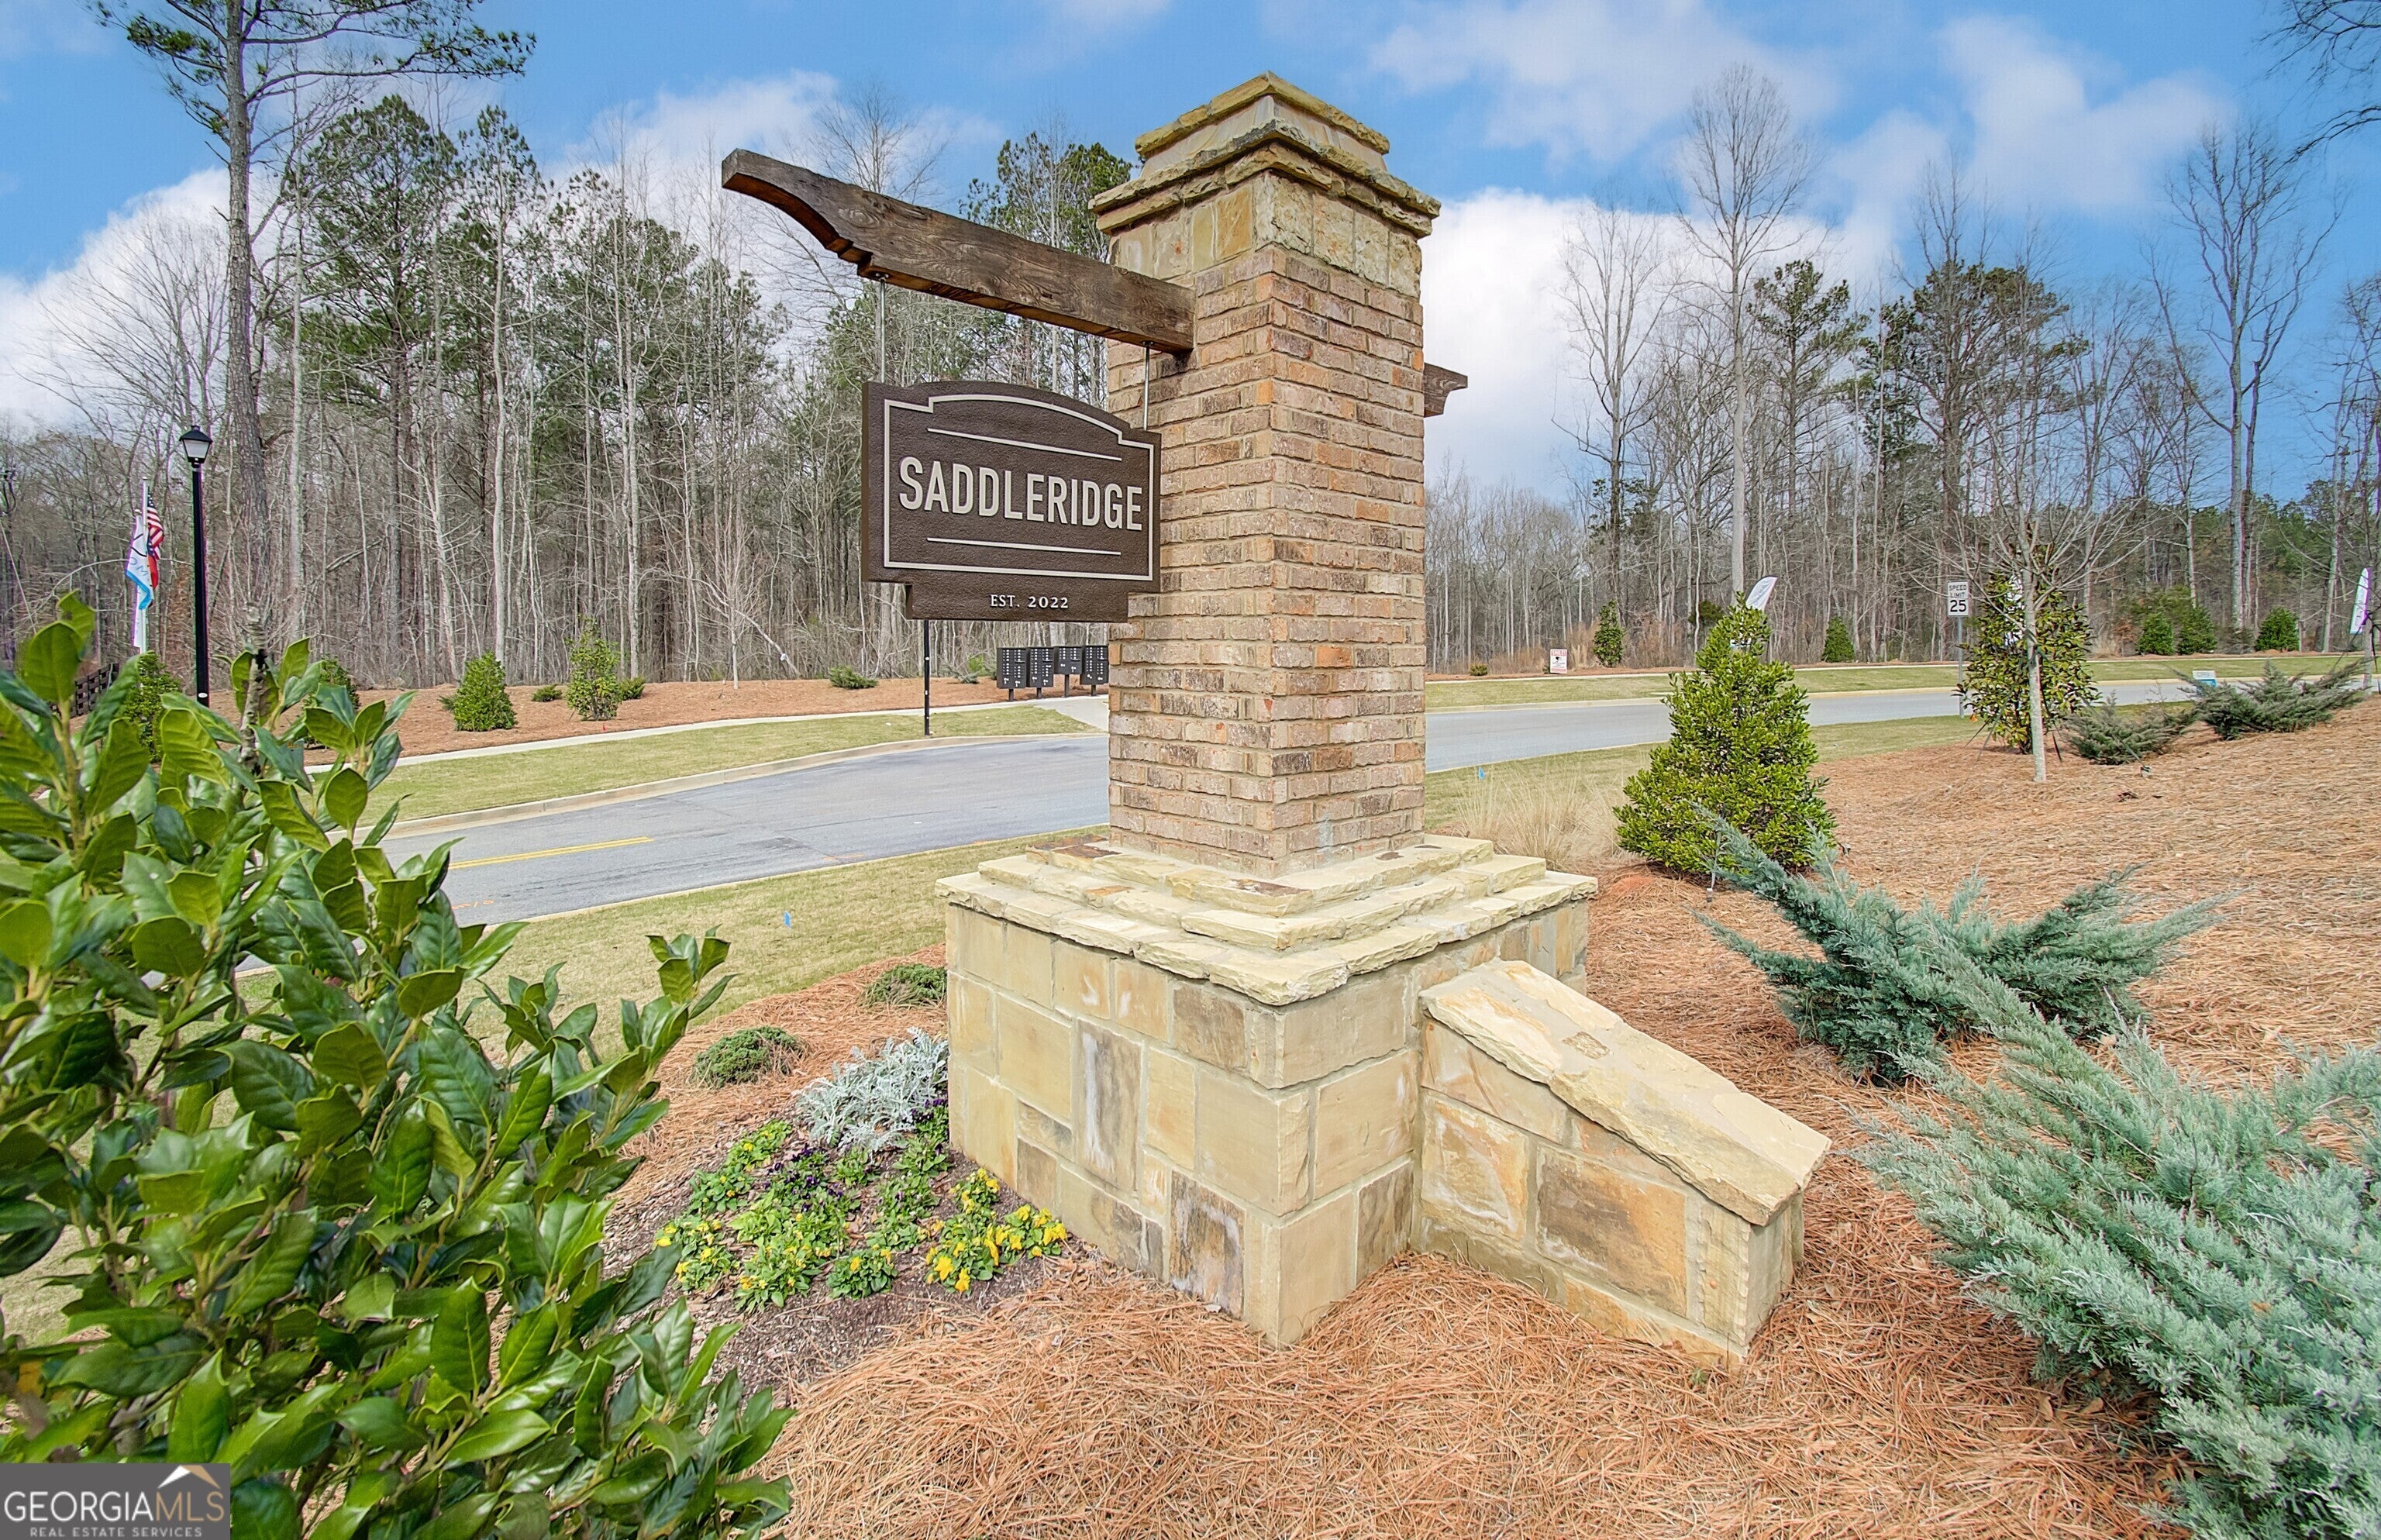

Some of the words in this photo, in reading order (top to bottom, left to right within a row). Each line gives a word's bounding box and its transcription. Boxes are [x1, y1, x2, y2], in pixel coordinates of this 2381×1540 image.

[899, 456, 1142, 530] SADDLERIDGE
[991, 594, 1020, 607] EST.
[1028, 596, 1069, 608] 2022
[1950, 599, 1966, 612] 25
